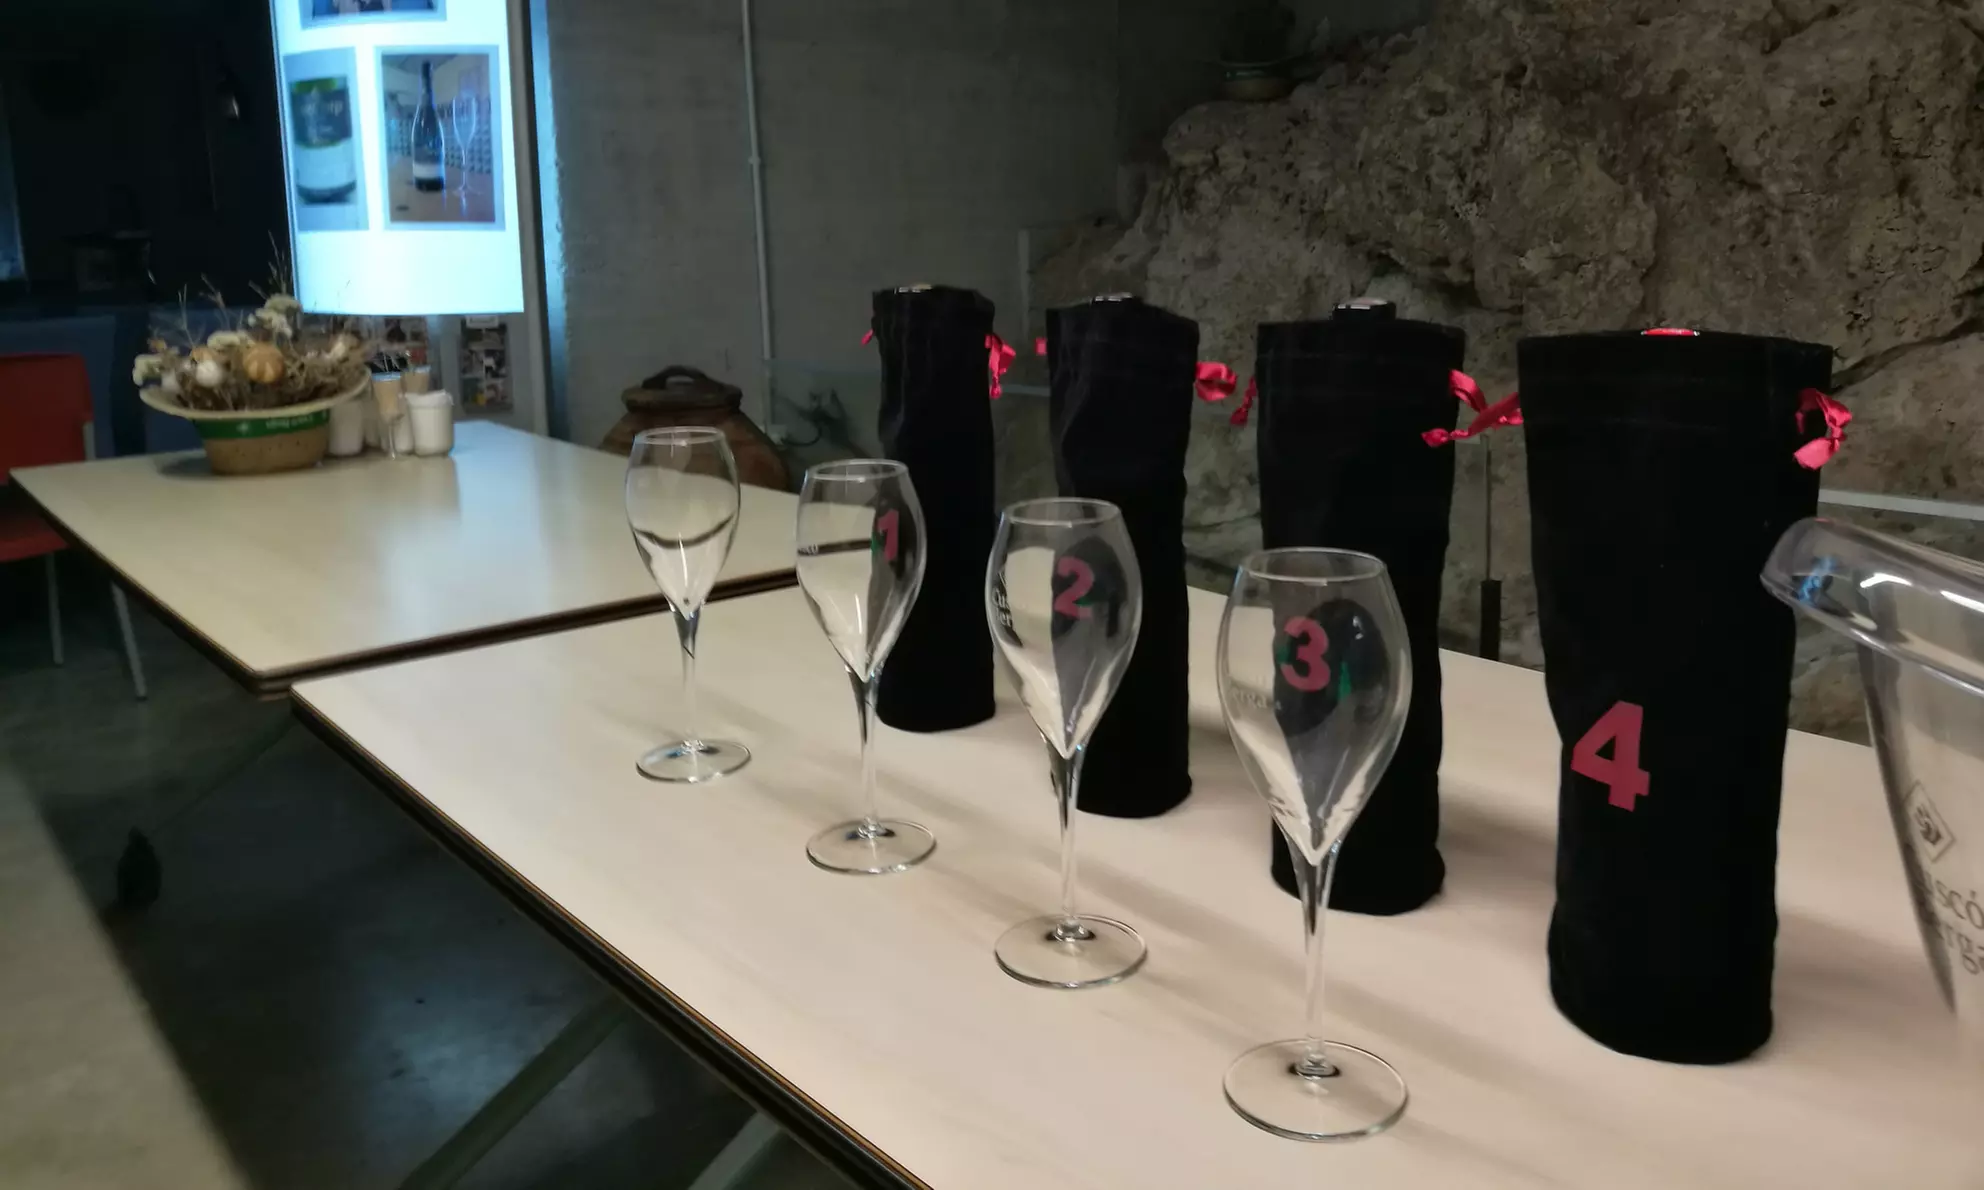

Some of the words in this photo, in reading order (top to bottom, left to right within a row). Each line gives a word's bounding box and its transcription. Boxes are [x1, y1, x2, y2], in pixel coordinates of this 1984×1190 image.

[877, 509, 899, 563] 1
[1054, 555, 1095, 622] 2
[1280, 616, 1330, 691] 3
[1570, 700, 1651, 812] 4
